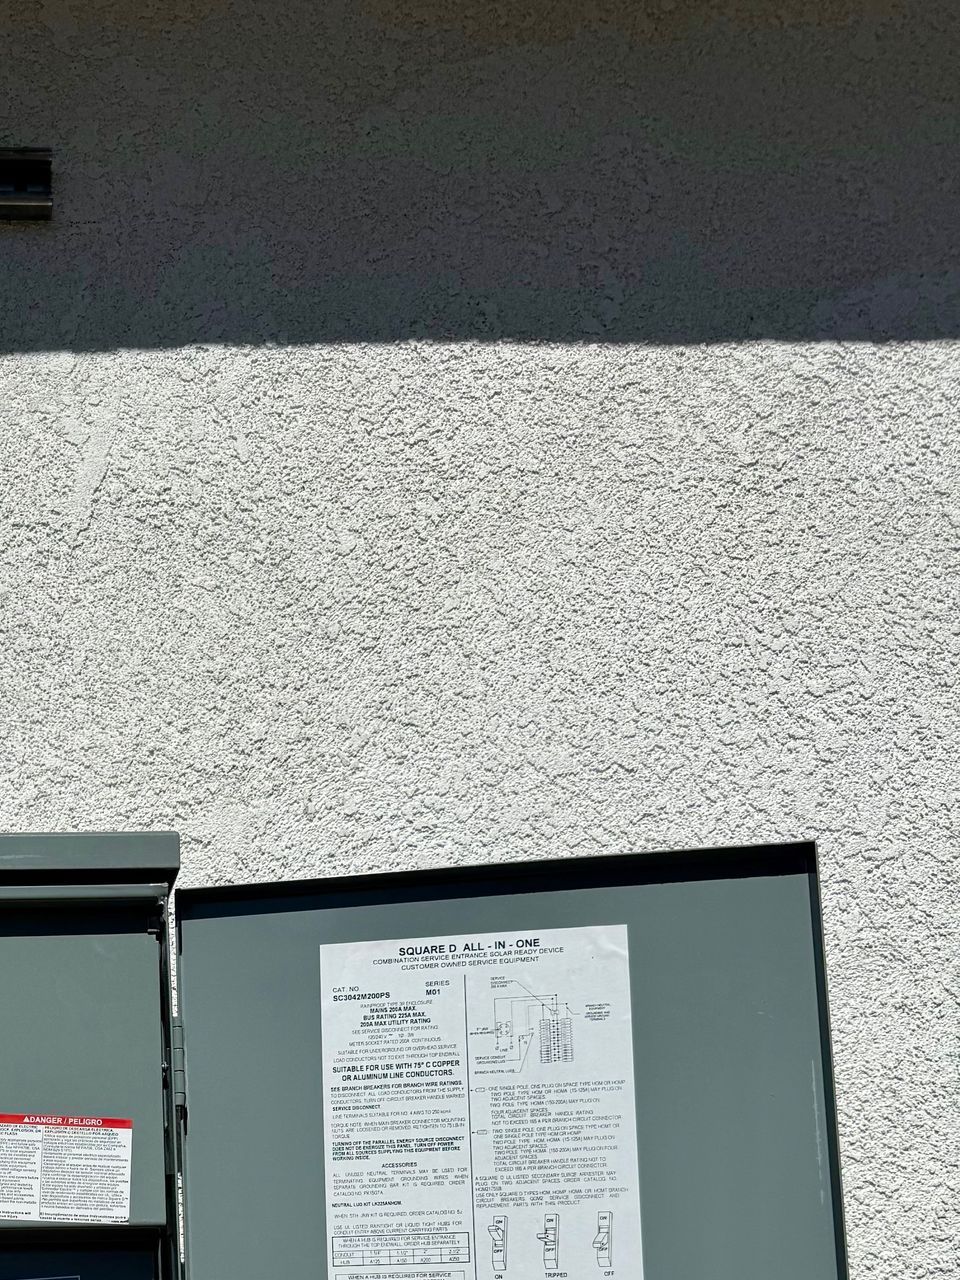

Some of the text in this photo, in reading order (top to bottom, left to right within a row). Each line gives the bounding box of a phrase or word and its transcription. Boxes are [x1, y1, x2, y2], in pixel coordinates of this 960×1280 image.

[398, 944, 445, 956] SQUARE
[448, 944, 457, 953] D
[462, 942, 484, 952] ALL
[494, 940, 505, 949] IN
[515, 938, 540, 948] ONE
[372, 957, 419, 965] COMBINATION
[401, 962, 439, 970] CUSTOMER
[499, 955, 539, 964] EQUIPMENT
[333, 991, 390, 1001] SC3042M200PS
[29, 1116, 62, 1124] DANGER
